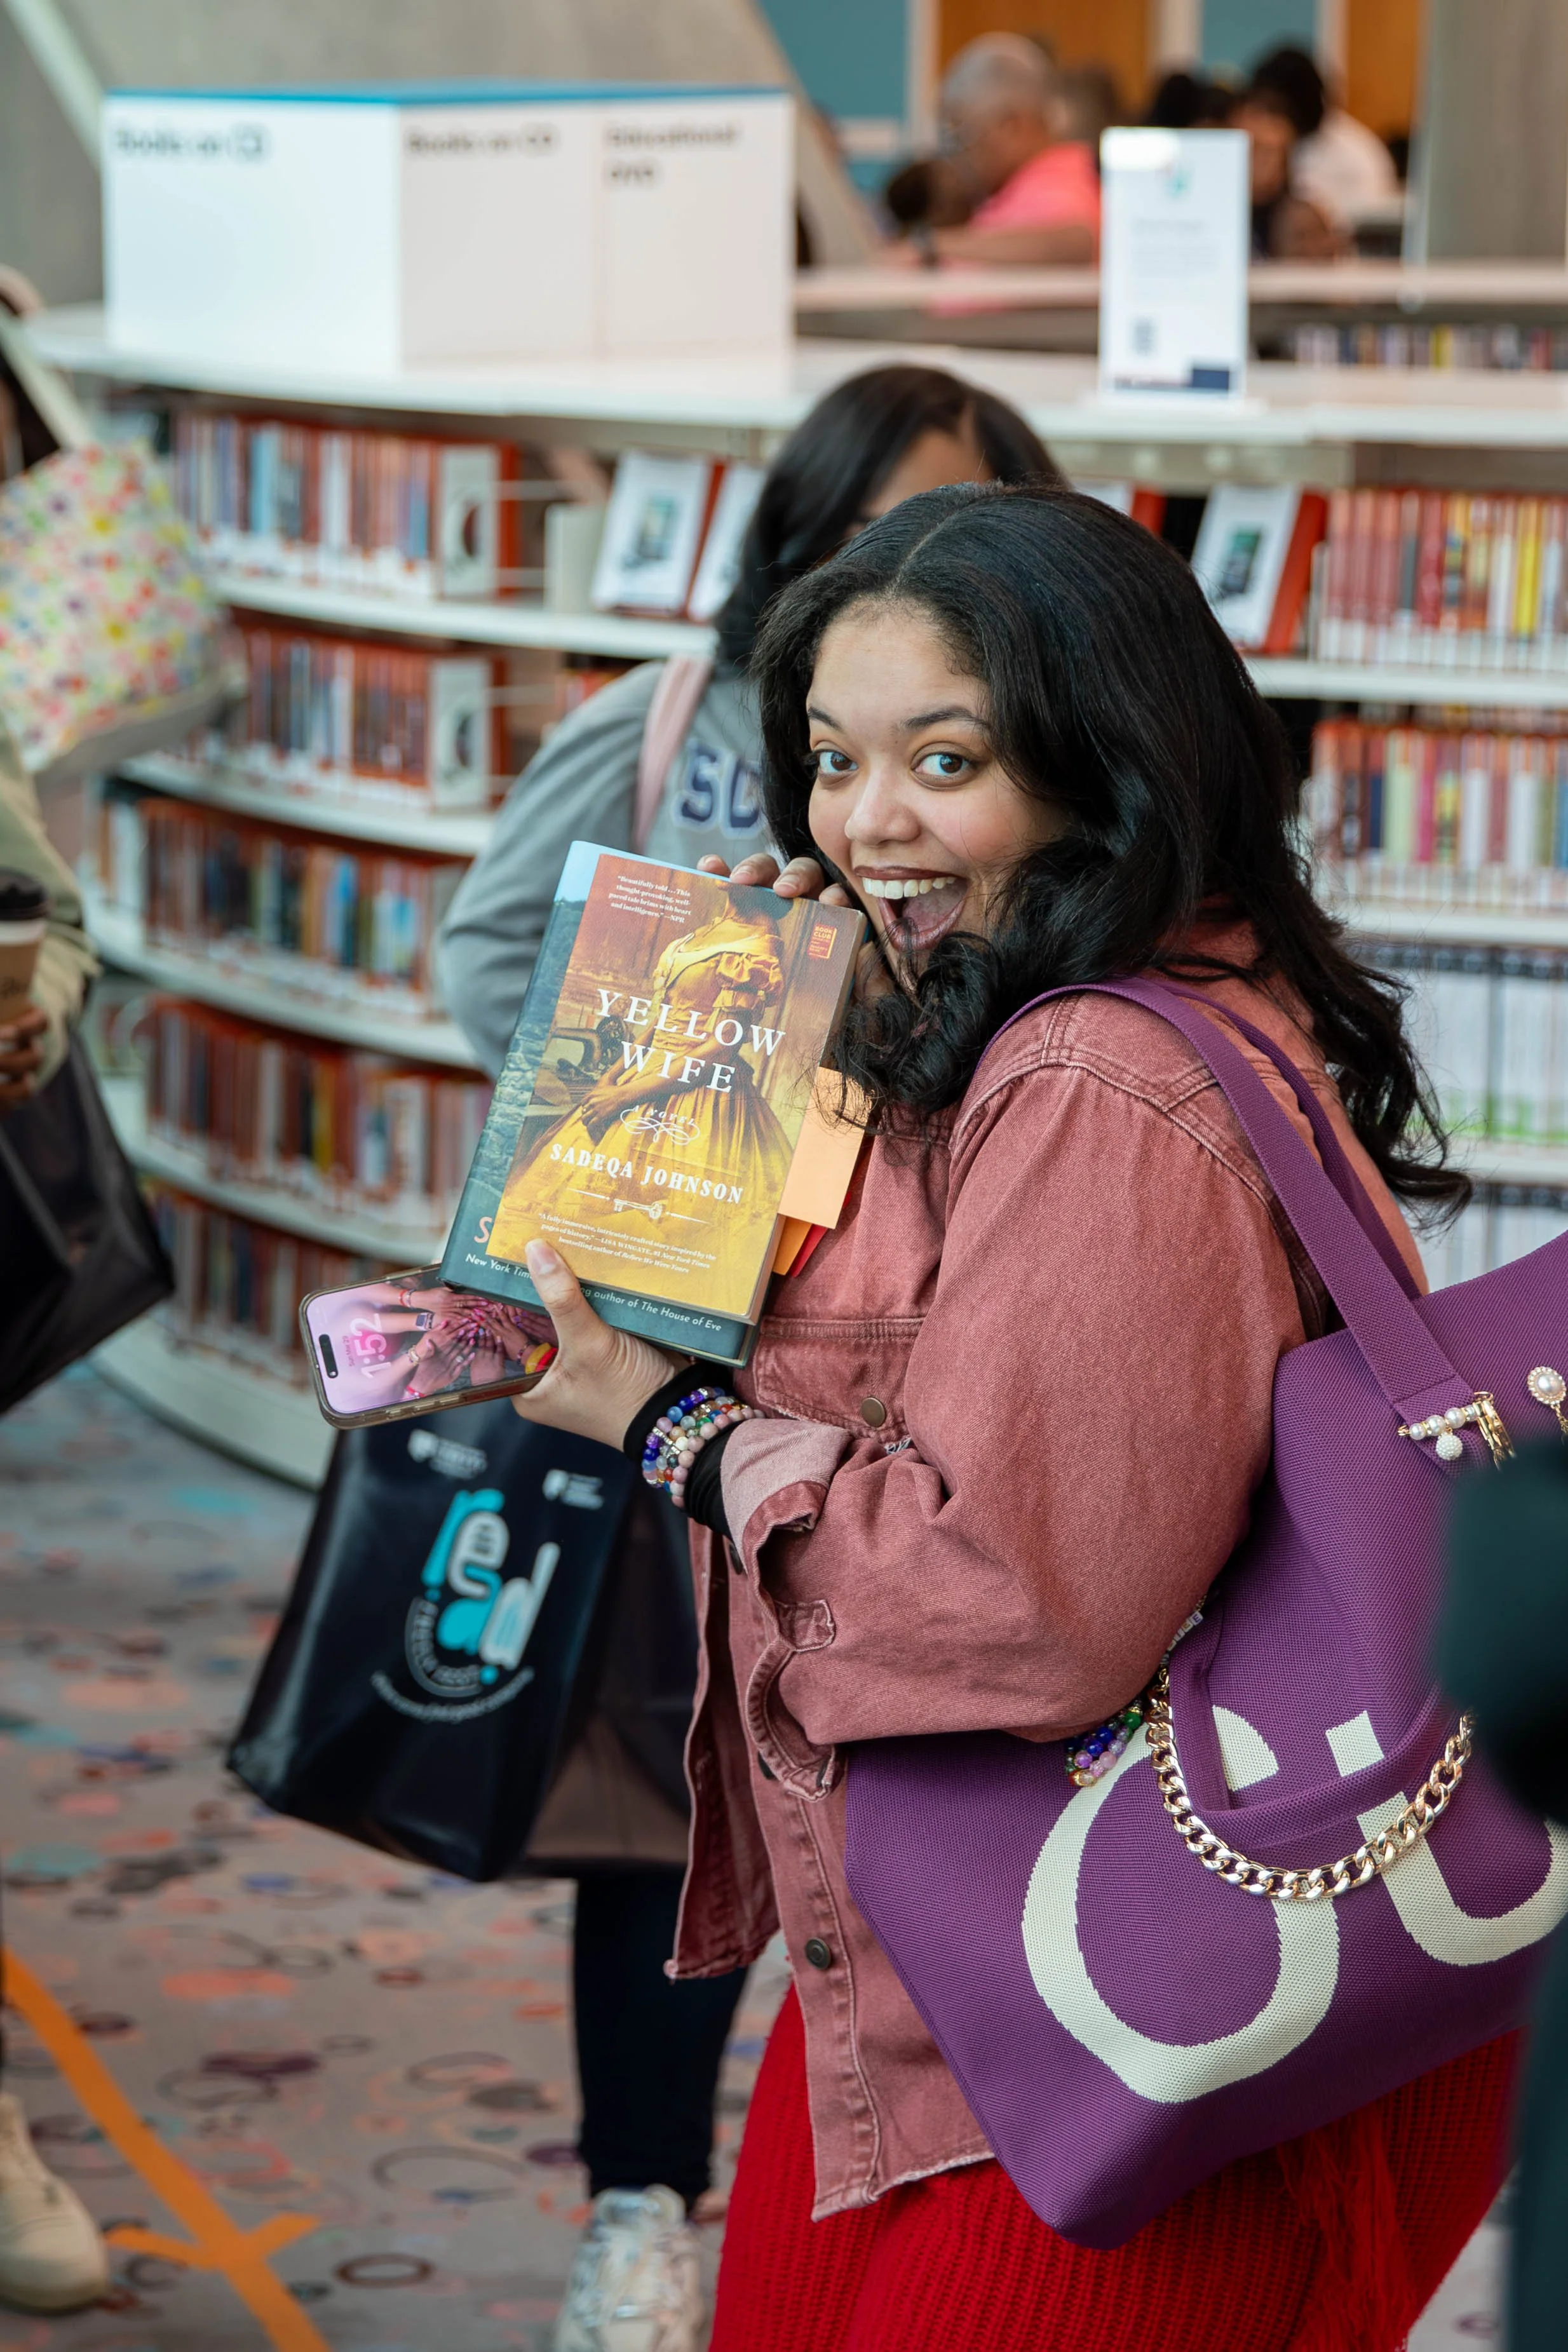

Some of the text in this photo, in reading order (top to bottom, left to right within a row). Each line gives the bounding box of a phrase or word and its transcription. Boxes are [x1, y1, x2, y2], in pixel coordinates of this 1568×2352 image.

[609, 893, 628, 901] paced
[640, 898, 659, 908] brims
[659, 903, 673, 912] with
[674, 906, 691, 916] heart
[597, 989, 785, 1056] YELLOW
[621, 1041, 735, 1093] WIFE
[645, 1108, 694, 1125] NOVEL
[550, 1144, 743, 1204] SADEQA JOHNSON
[541, 1224, 559, 1232] pages
[661, 1252, 675, 1261] New
[676, 1255, 691, 1264] York
[691, 1260, 710, 1269] Times
[547, 1215, 563, 1225] fully
[597, 1227, 629, 1241] intricately
[630, 1236, 653, 1246] crafted
[653, 1241, 670, 1251] story
[671, 1245, 697, 1257] inspired
[697, 1251, 706, 1259] by
[705, 1253, 717, 1261] the
[558, 1236, 593, 1251] bestselling
[593, 1245, 614, 1255] author
[621, 1252, 643, 1262] Before
[654, 1259, 671, 1269] Were
[671, 1264, 689, 1273] Yours
[465, 1253, 487, 1266] New
[490, 1259, 510, 1274] York
[594, 1290, 625, 1305] author
[627, 1299, 640, 1308] of
[641, 1301, 658, 1314] The
[661, 1307, 690, 1323] House
[692, 1316, 705, 1327] of
[705, 1321, 722, 1332] Eve
[350, 1313, 391, 1379] 1:52
